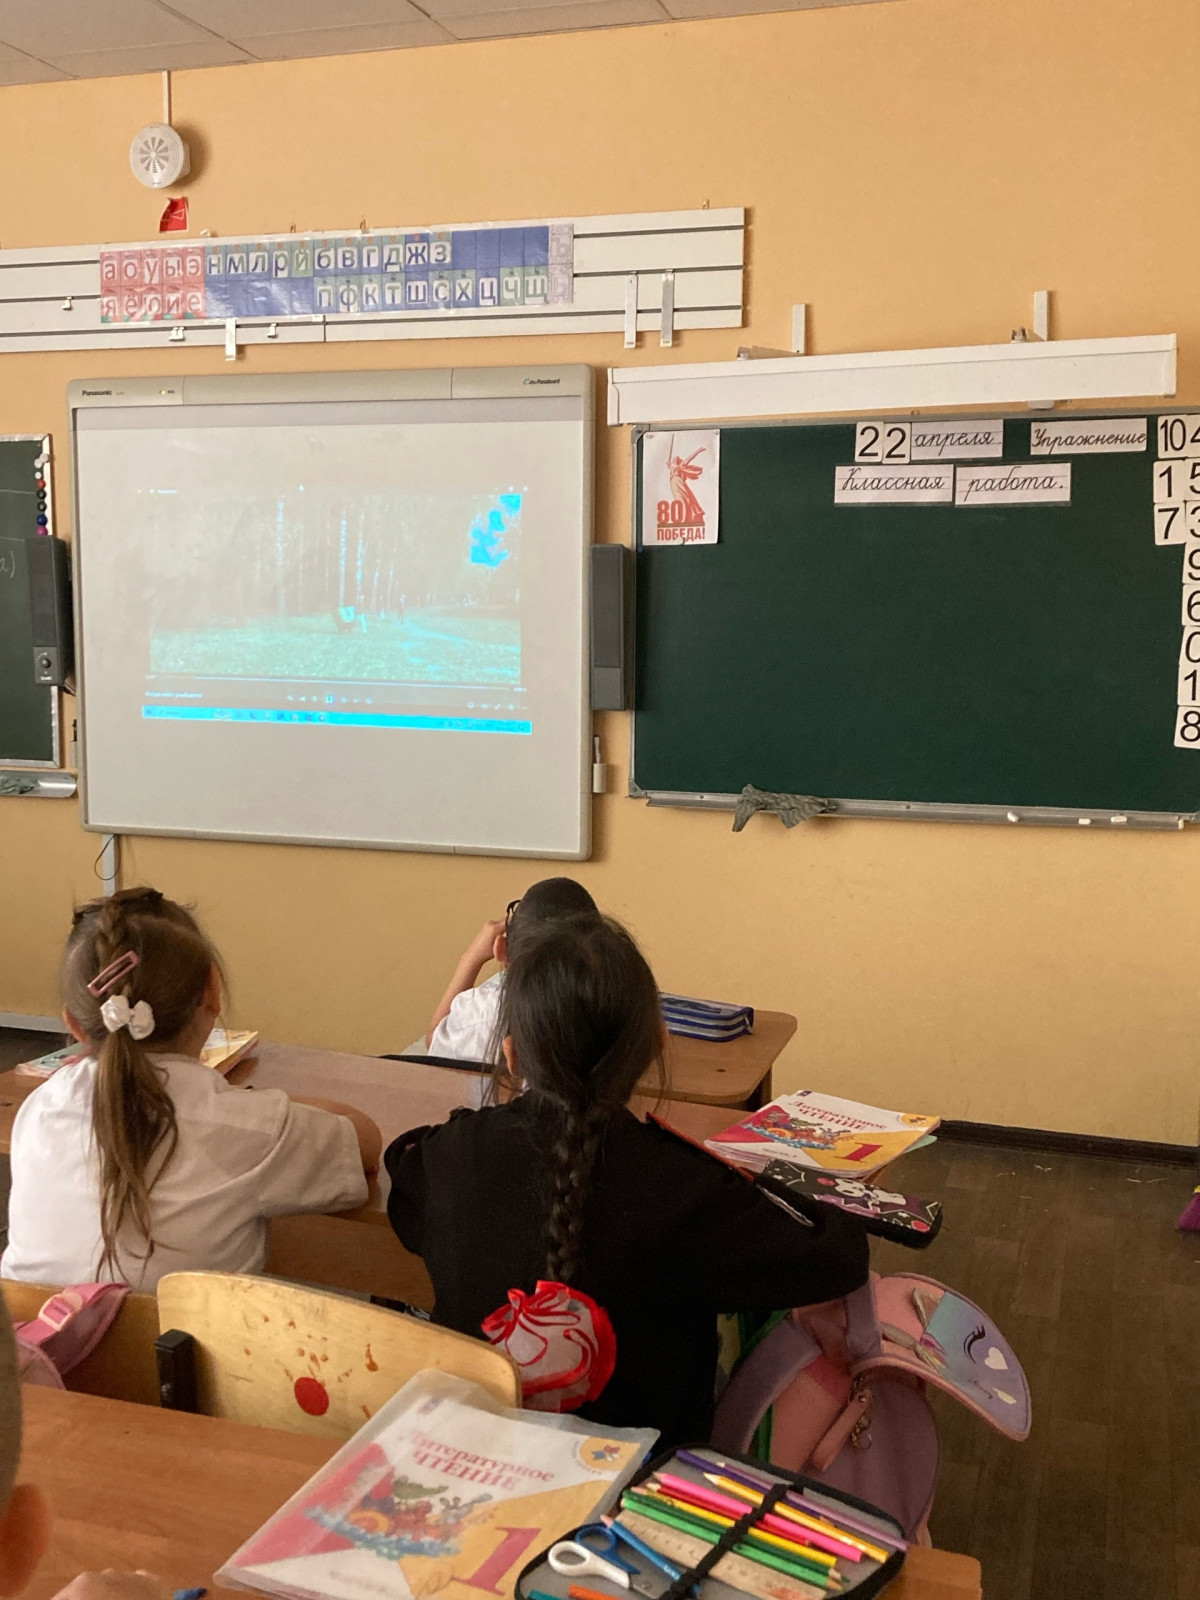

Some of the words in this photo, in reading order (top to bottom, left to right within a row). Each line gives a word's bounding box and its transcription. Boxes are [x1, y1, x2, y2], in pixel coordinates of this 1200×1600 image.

[104, 263, 116, 280] а
[124, 262, 138, 280] о
[144, 258, 158, 282] у
[165, 257, 181, 276] ы
[187, 256, 200, 275] э
[208, 255, 221, 275] н
[227, 254, 245, 273] м
[251, 252, 267, 272] л
[274, 251, 288, 278] р
[295, 247, 309, 271] й
[317, 247, 331, 268] б
[342, 249, 355, 268] в
[366, 248, 377, 267] г
[385, 247, 402, 271] д
[406, 246, 428, 264] ж
[434, 244, 447, 263] з
[104, 297, 117, 315] я
[166, 293, 181, 312] и
[187, 292, 201, 311] е
[340, 283, 356, 311] ф
[366, 285, 379, 305] к
[386, 285, 399, 303] т
[407, 282, 427, 303] ш
[434, 281, 447, 301] с
[457, 281, 472, 301] х
[481, 279, 496, 305] ц
[504, 278, 518, 298] ч
[526, 277, 547, 303] щ
[858, 425, 906, 458] 22
[1032, 428, 1147, 455] Упражнение
[842, 468, 945, 490] Классная
[964, 466, 1064, 501] работа.
[657, 500, 683, 523] 80
[657, 527, 705, 541] ПОБЕДА!
[834, 1142, 882, 1163] 1
[452, 1526, 542, 1596] 1
